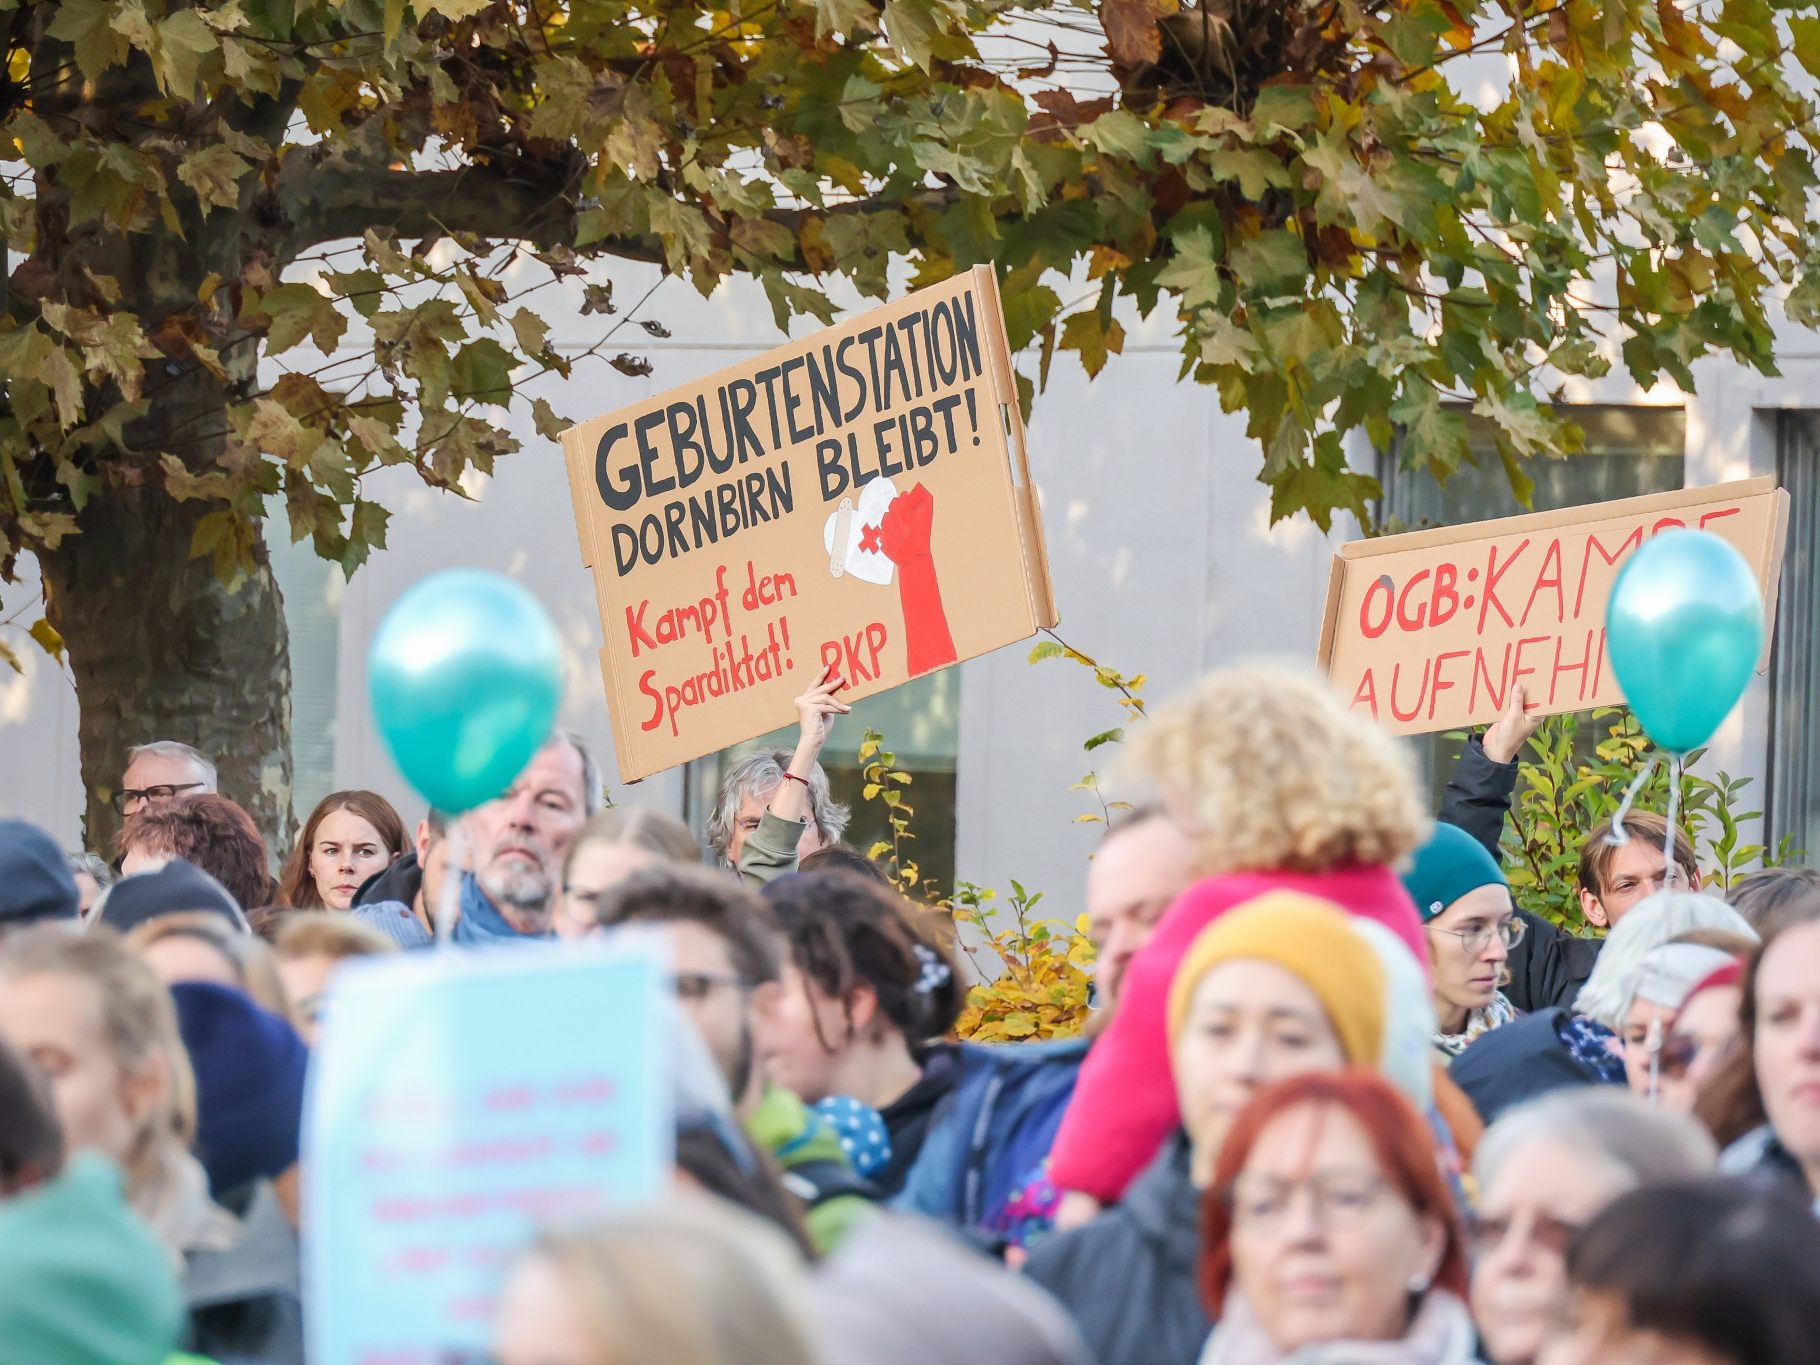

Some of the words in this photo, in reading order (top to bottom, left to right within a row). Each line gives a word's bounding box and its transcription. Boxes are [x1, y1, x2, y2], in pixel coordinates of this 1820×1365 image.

[596, 291, 982, 511] GEBURTENSTATION
[612, 460, 794, 577] DORNBIRN
[816, 388, 981, 502] BLEIBT!
[626, 565, 733, 657] Kampf
[821, 622, 887, 691] RKP
[639, 616, 795, 737] Spardiktat!
[1350, 626, 1606, 722] AUFNEH
